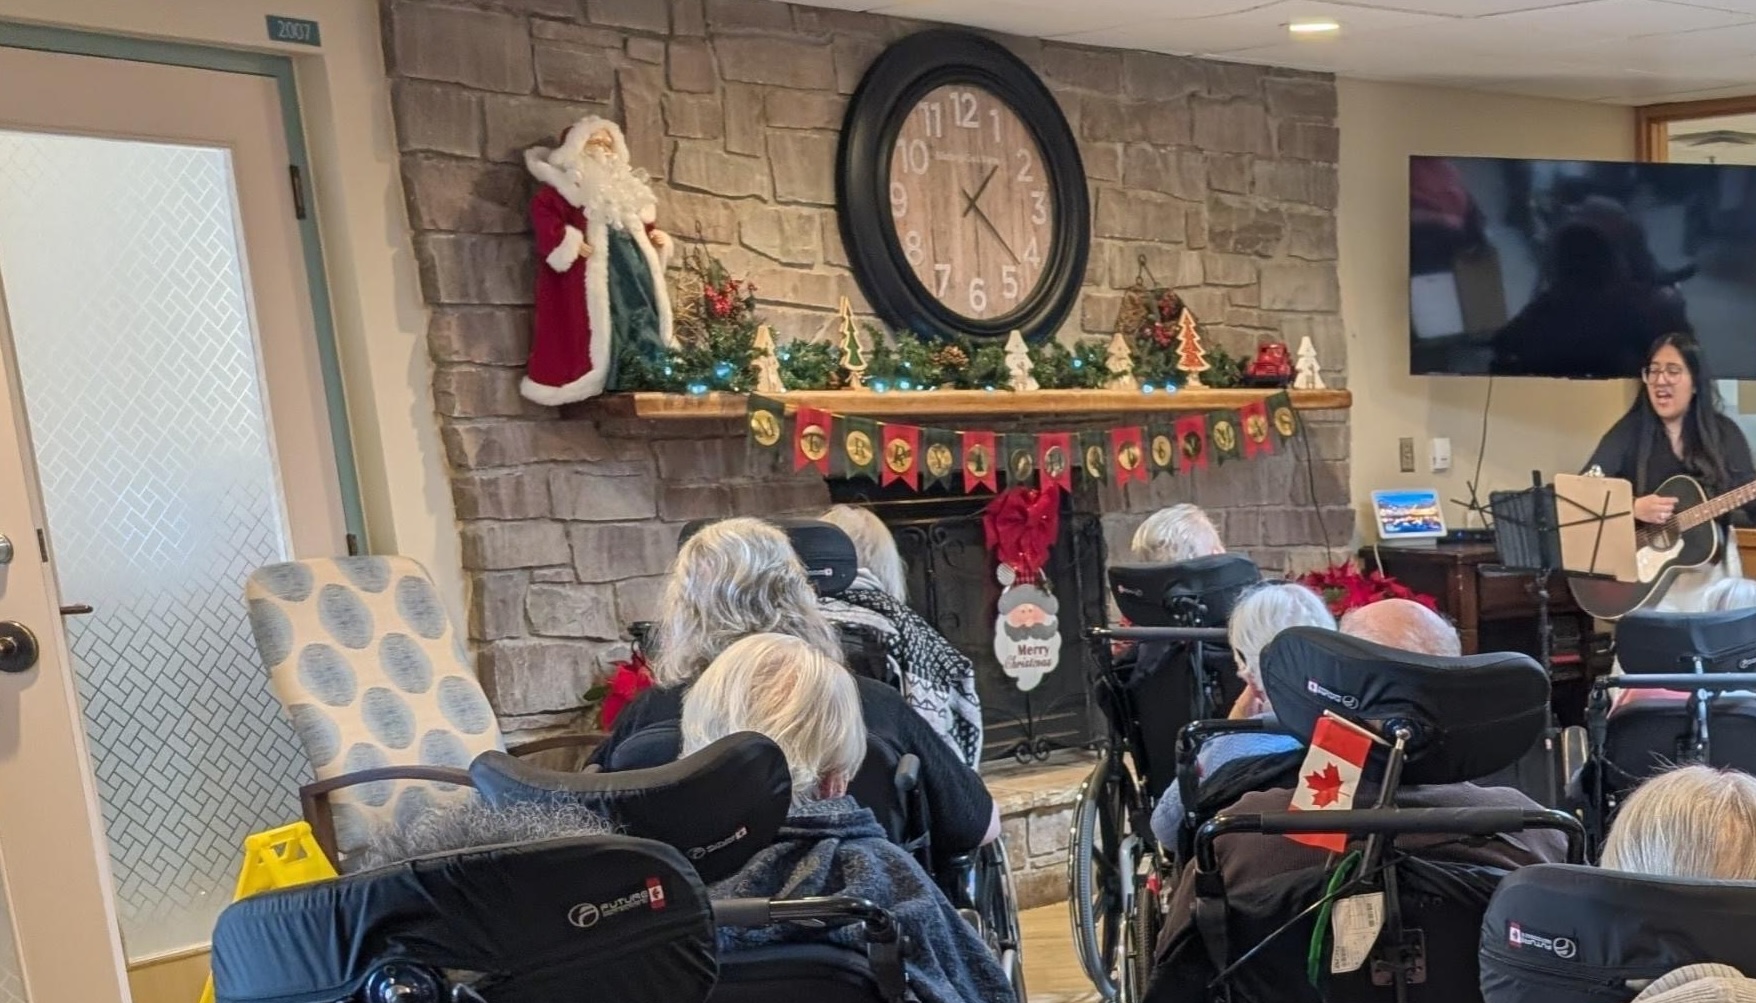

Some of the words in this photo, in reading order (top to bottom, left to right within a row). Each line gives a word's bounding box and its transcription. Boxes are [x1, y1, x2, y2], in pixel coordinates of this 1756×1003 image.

[277, 20, 310, 40] 2007
[919, 101, 942, 137] 11
[950, 92, 980, 128] 12
[990, 108, 1001, 143] 1
[897, 138, 929, 175] 10
[1016, 148, 1034, 182] 2
[890, 181, 907, 218] 9
[1031, 191, 1046, 225] 3
[905, 230, 925, 266] 8
[1023, 236, 1041, 269] 4
[934, 263, 951, 297] 7
[969, 278, 987, 312] 6
[1002, 265, 1018, 299] 5
[1018, 644, 1049, 657] Merry
